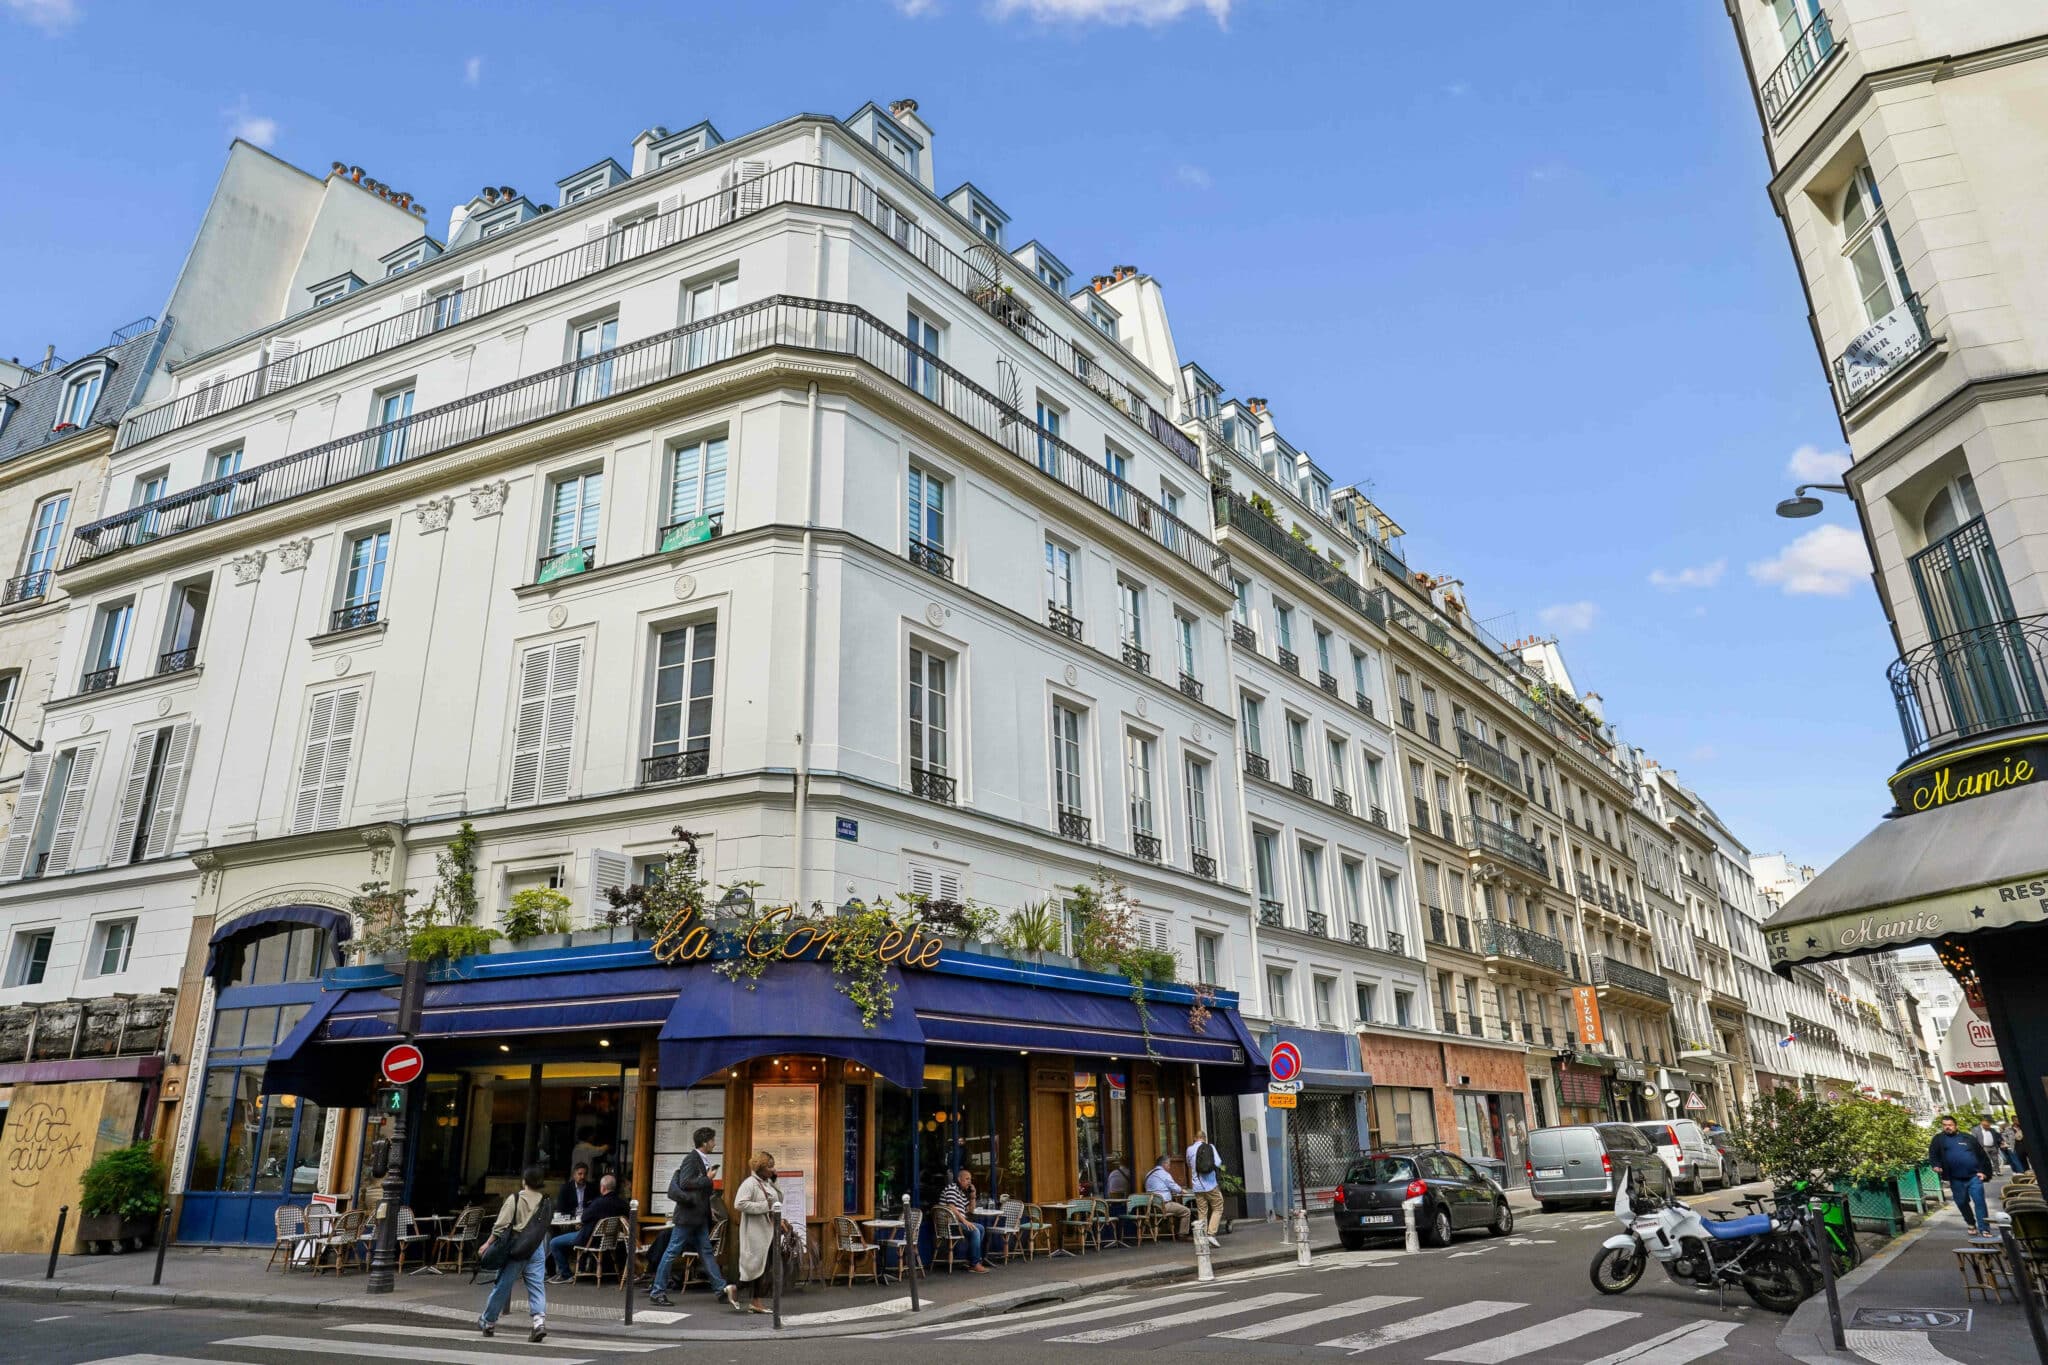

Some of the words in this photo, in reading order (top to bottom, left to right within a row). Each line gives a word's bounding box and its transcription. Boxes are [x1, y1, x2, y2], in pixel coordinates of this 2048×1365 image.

[1851, 376, 1862, 389] 06
[1887, 346, 1902, 360] 22
[1904, 333, 1918, 347] 82
[1913, 757, 2034, 810] Mamie
[651, 906, 712, 960] la
[1840, 911, 1943, 946] Mamie
[1580, 989, 1596, 1041] MIZNON
